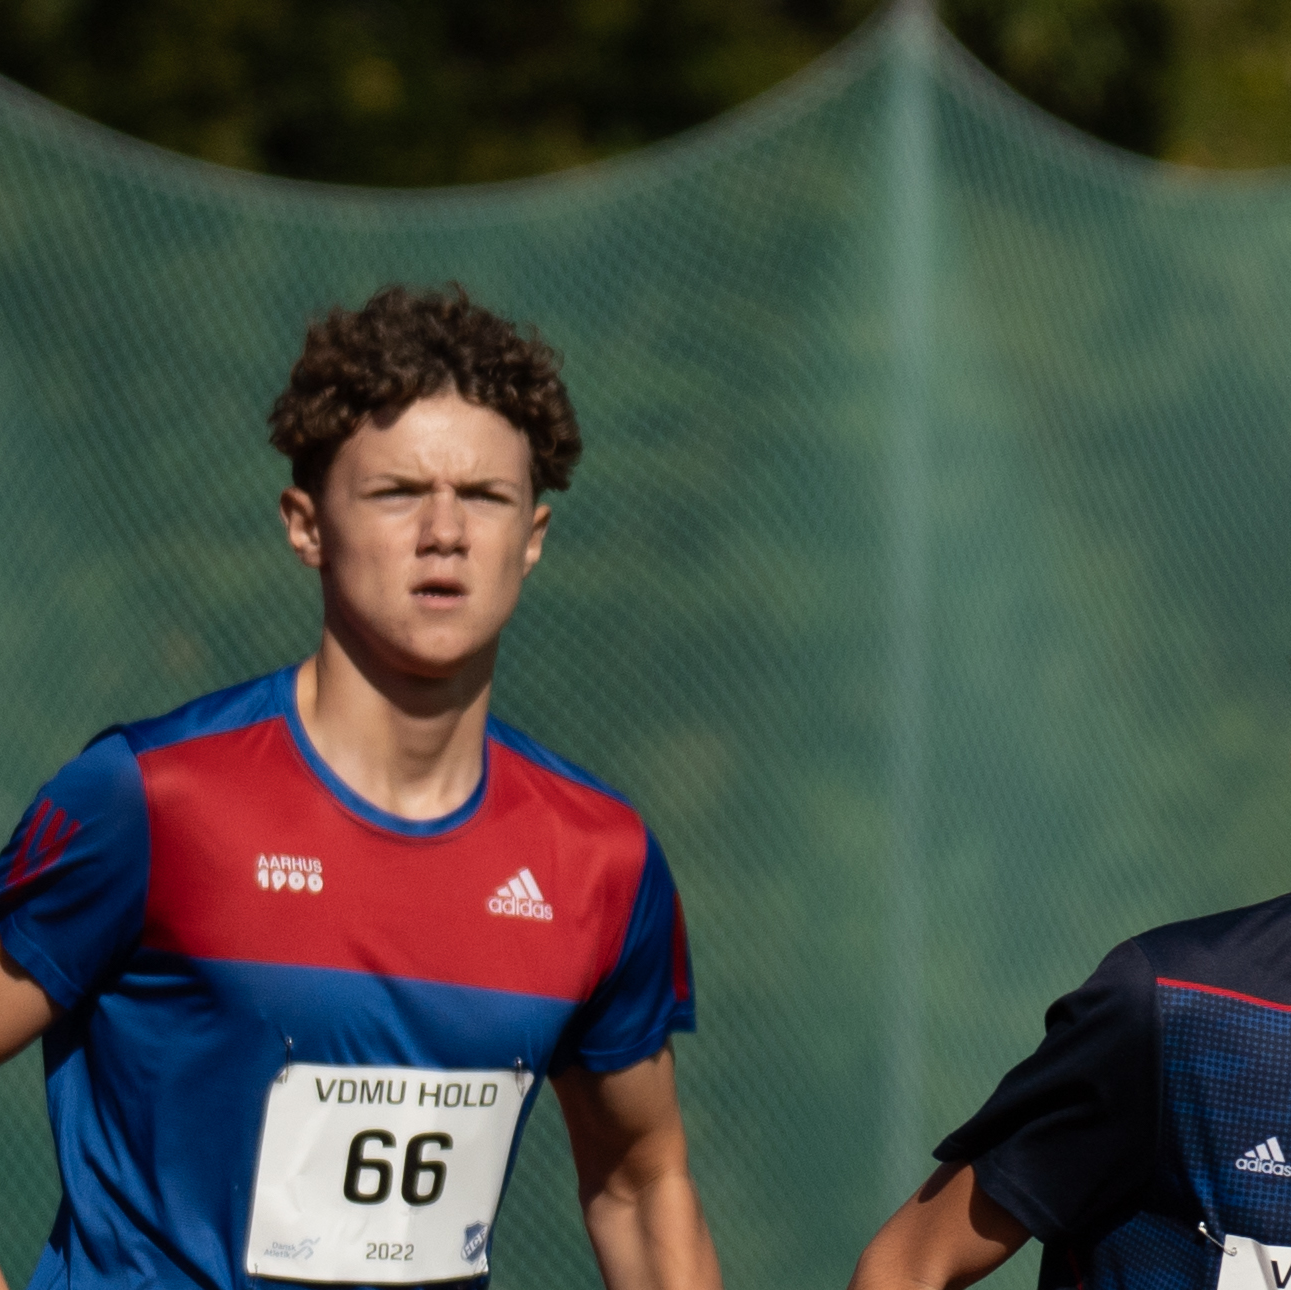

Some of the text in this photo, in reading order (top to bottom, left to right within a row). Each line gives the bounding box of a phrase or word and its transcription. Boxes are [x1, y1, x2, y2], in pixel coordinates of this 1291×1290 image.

[257, 853, 323, 874] AARHUS
[257, 868, 324, 892] 1900
[487, 895, 553, 920] adidas
[315, 1077, 498, 1108] VDMU HOLD
[343, 1128, 454, 1207] 66
[365, 1242, 415, 1262] 2022
